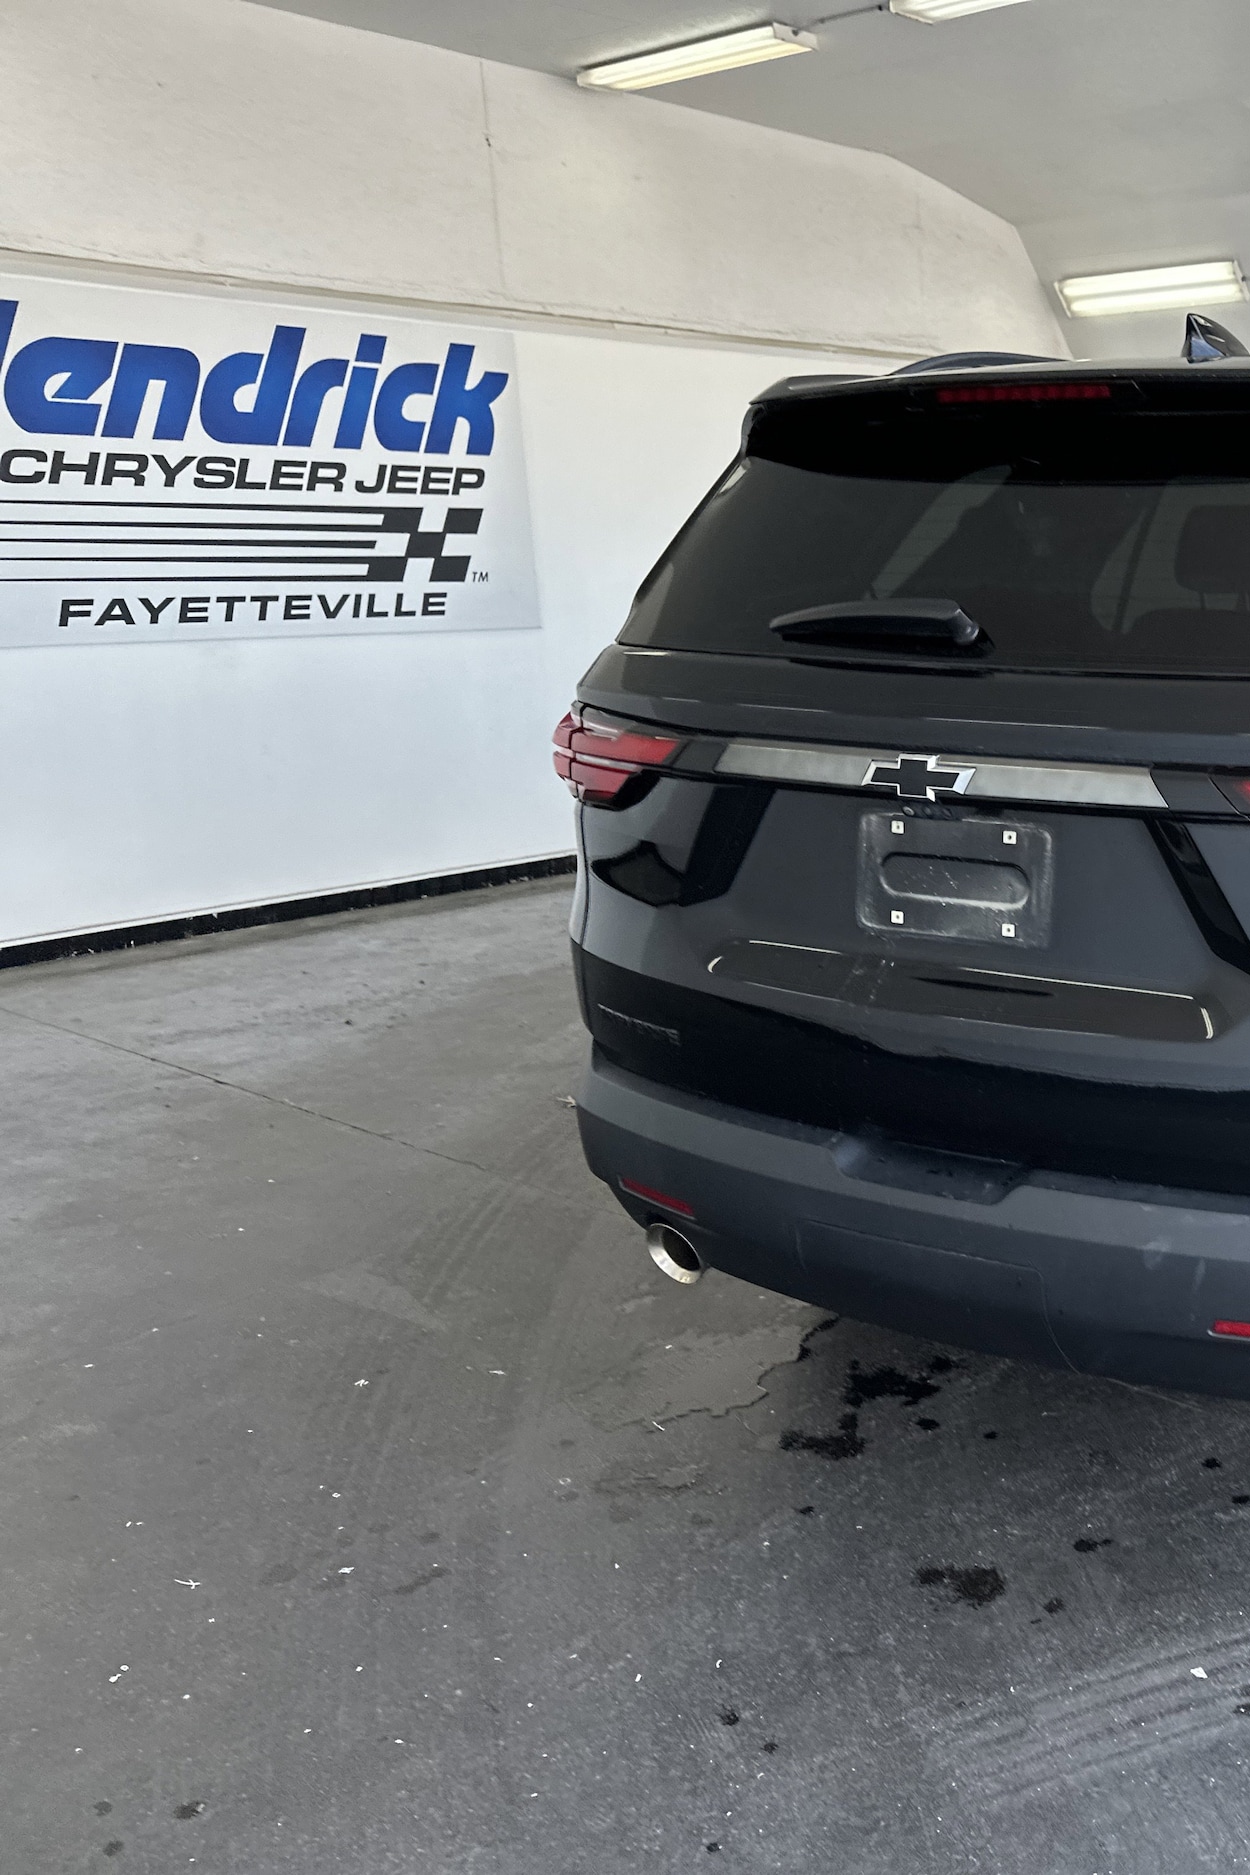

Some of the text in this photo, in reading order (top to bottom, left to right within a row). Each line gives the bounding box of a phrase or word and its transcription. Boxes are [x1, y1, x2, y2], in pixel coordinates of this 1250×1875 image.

[0, 299, 509, 456] endrick
[0, 449, 486, 496] CHRYSLER JEEP
[471, 571, 489, 583] TM
[58, 592, 448, 627] FAYETTEVILLE
